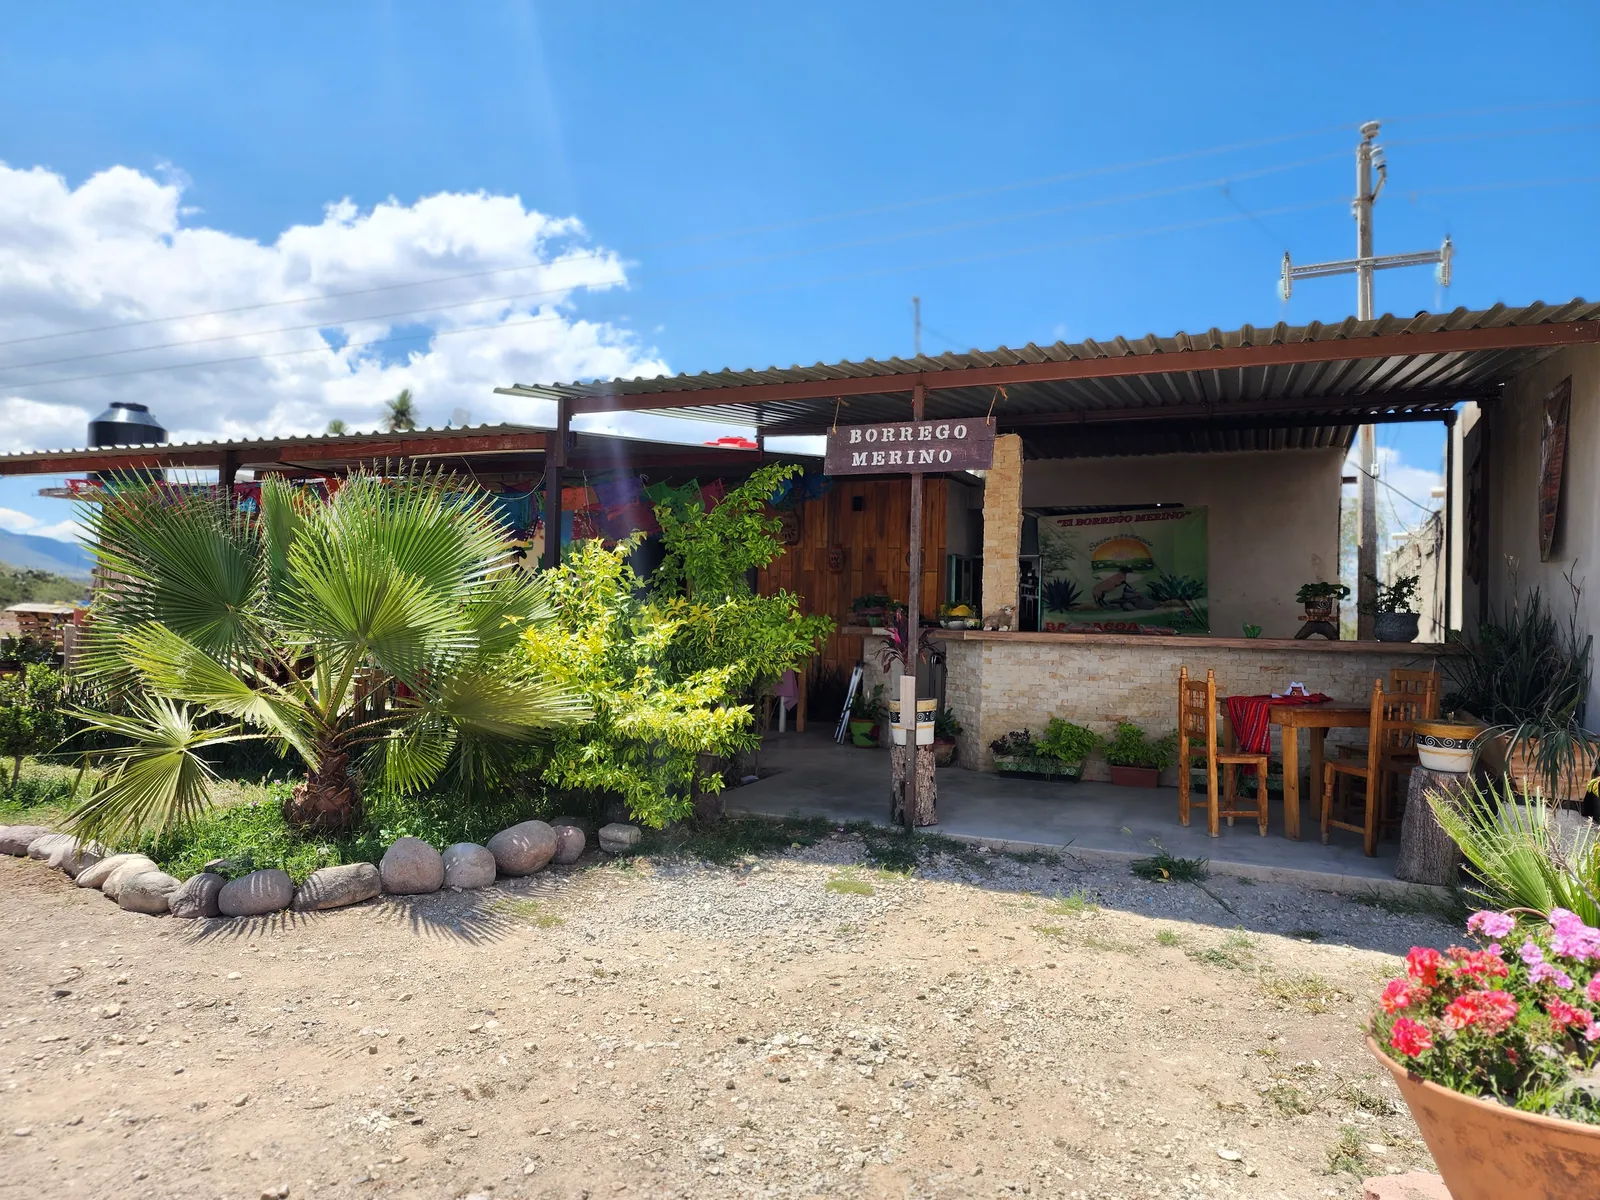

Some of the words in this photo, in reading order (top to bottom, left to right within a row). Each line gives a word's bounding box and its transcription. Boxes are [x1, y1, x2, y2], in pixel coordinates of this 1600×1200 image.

[849, 424, 968, 444] BORREGO
[851, 449, 952, 467] MERINO
[1075, 515, 1133, 526] BORREGO
[1045, 621, 1140, 632] BAACOA
